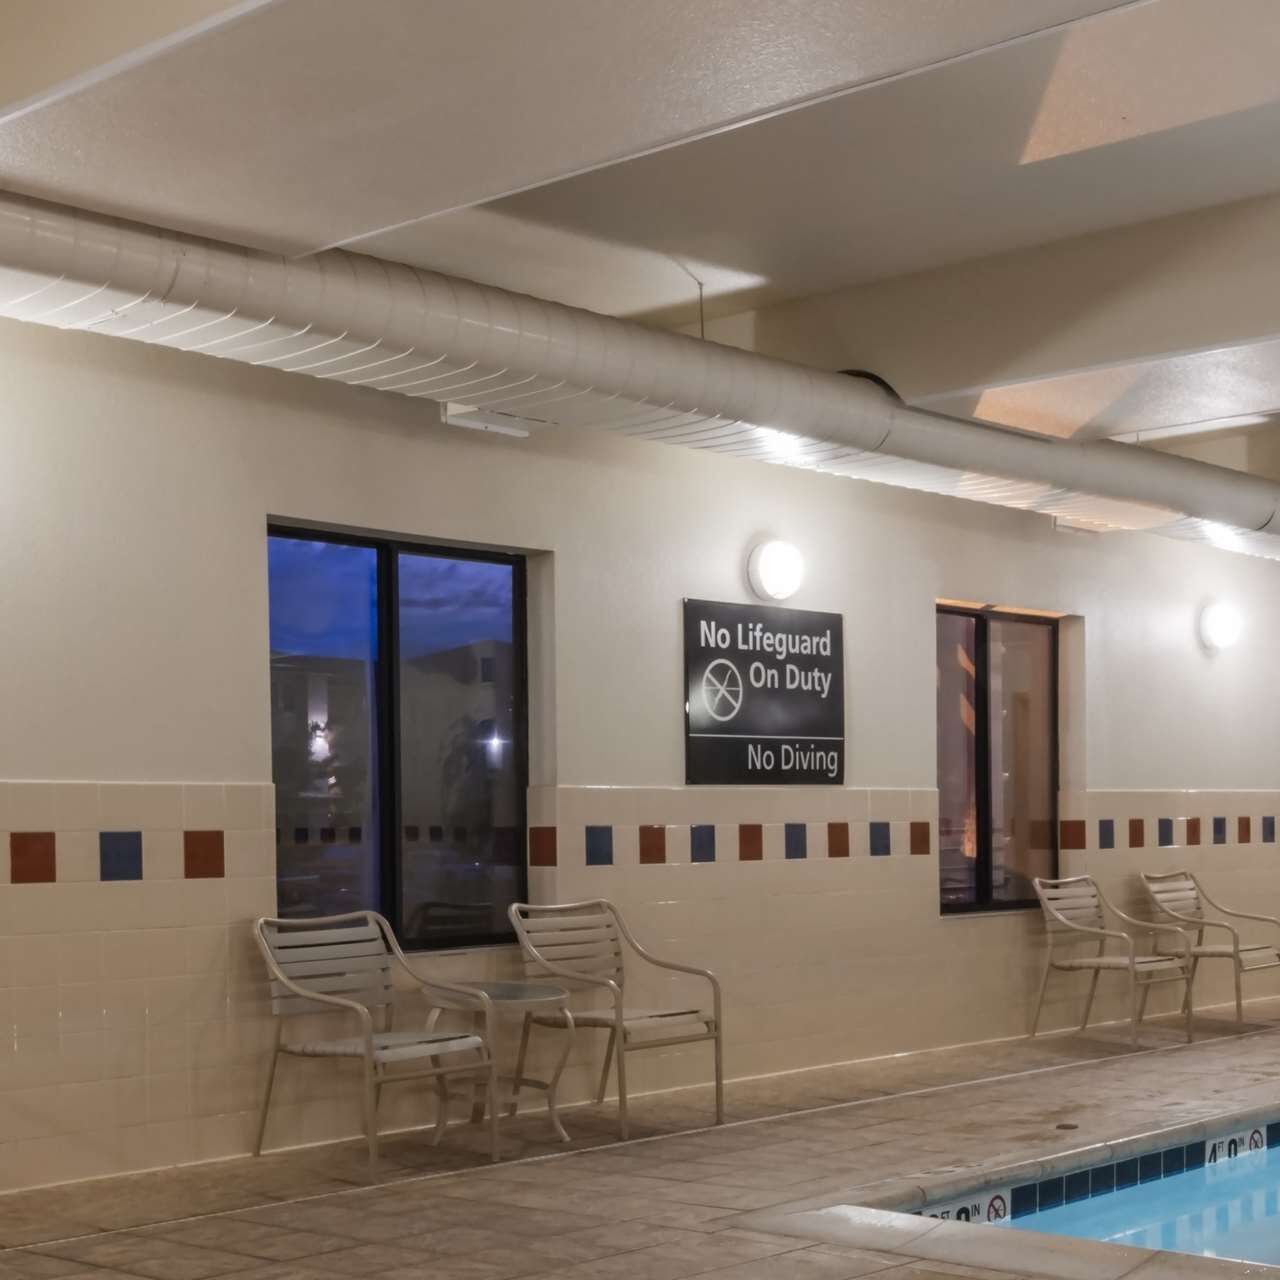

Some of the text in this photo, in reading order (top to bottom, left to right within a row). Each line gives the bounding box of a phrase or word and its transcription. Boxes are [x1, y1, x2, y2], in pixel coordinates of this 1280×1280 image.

[700, 620, 832, 660] No Lifeguard
[749, 662, 832, 698] On Duty
[748, 744, 838, 777] No Diving
[971, 1204, 980, 1216] IN
